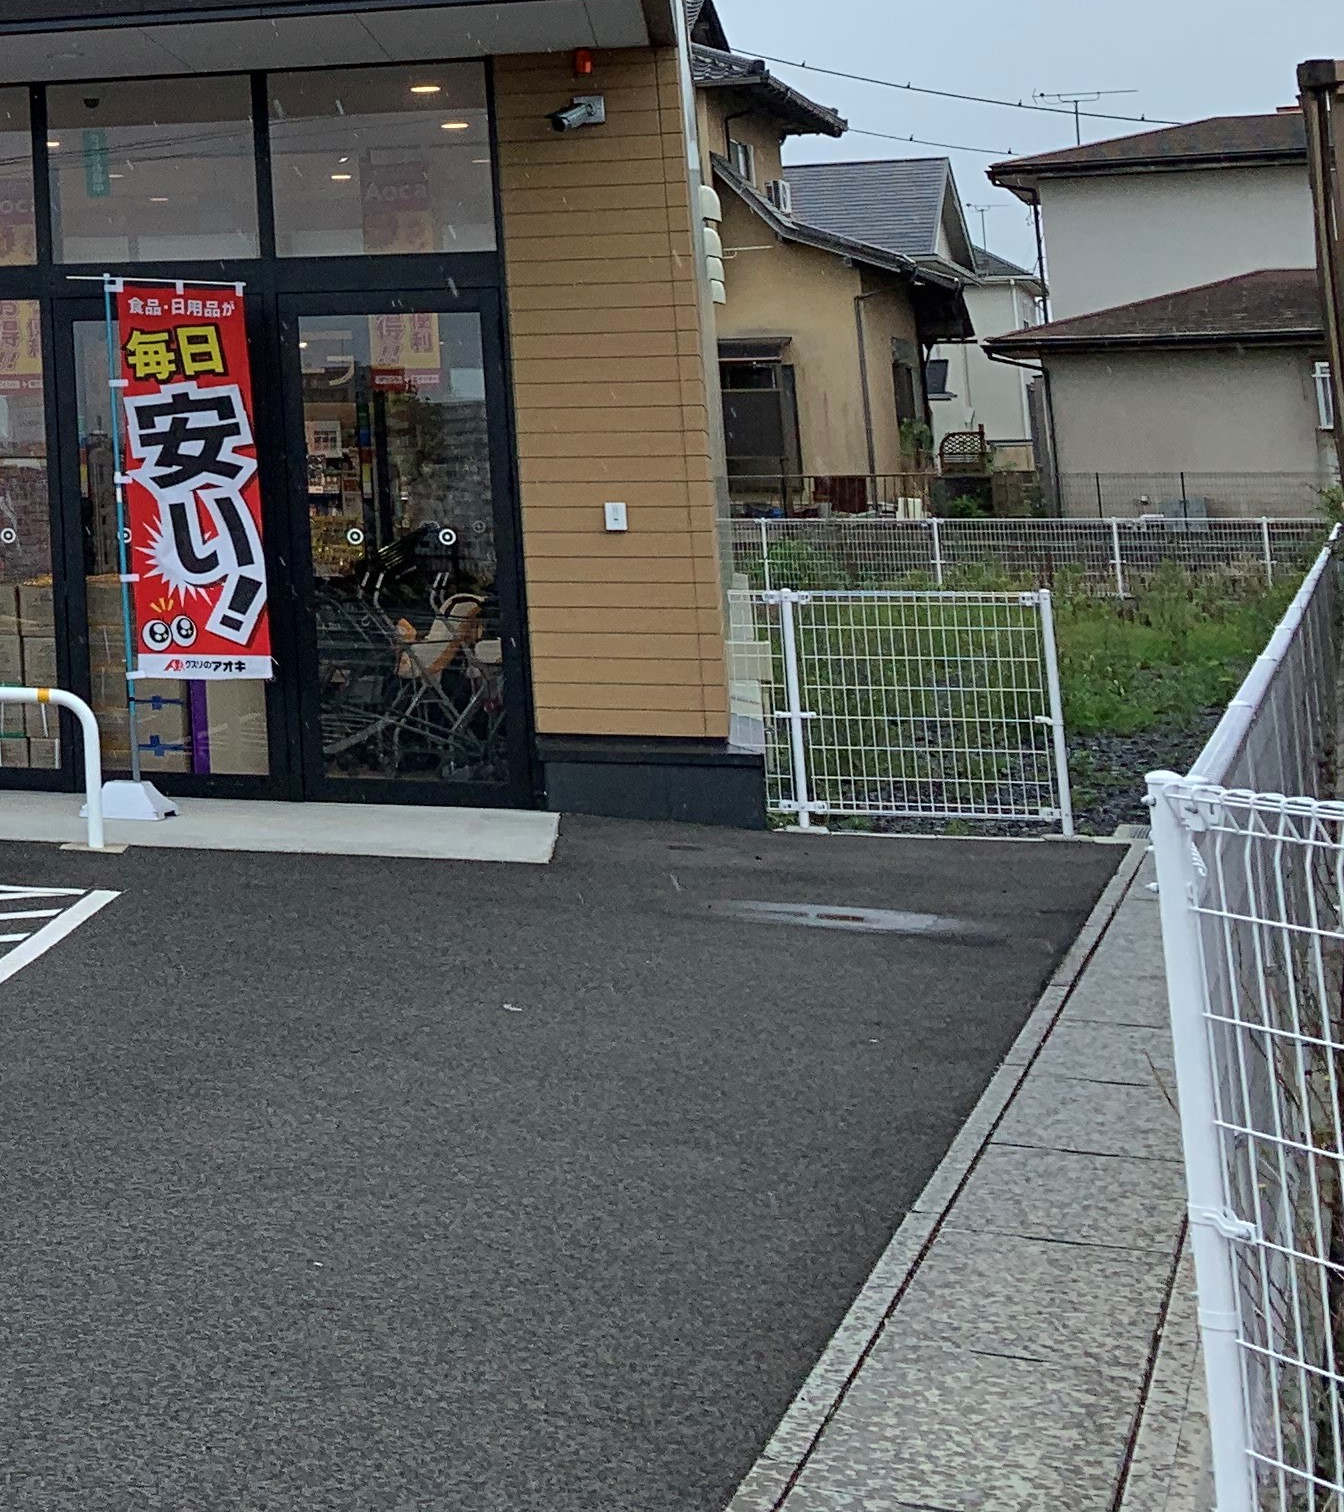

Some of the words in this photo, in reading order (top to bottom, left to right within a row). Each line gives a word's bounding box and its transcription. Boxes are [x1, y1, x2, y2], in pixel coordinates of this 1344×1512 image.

[127, 296, 236, 318] 食品・日用品が
[126, 325, 228, 381] 毎日
[185, 660, 246, 673] クスリのアオキ
